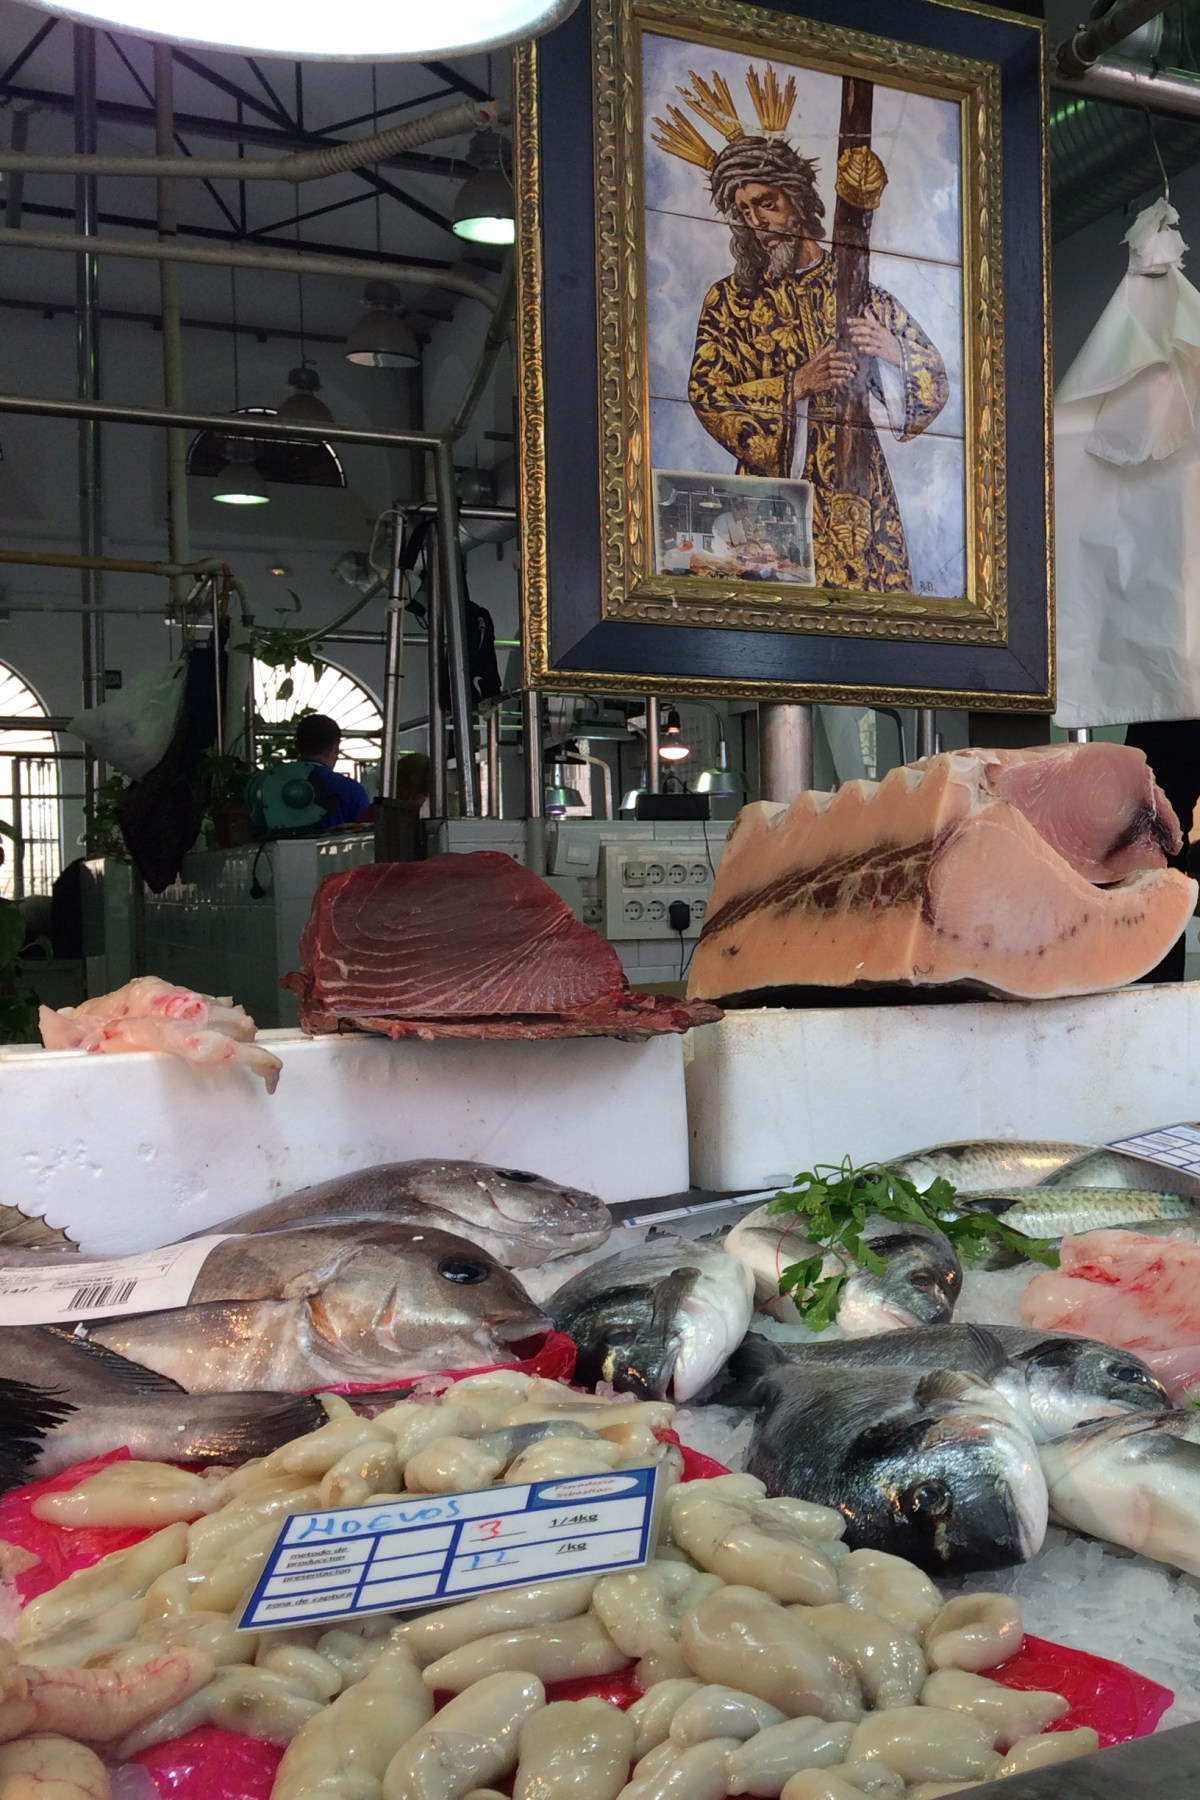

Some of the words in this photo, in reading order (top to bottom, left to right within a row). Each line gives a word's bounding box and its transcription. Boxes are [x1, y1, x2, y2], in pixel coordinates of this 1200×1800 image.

[479, 1520, 502, 1542] 3
[551, 1513, 598, 1527] 1/4kg
[557, 1542, 587, 1553] /kg
[265, 1601, 292, 1610] zona
[294, 1598, 310, 1606] de
